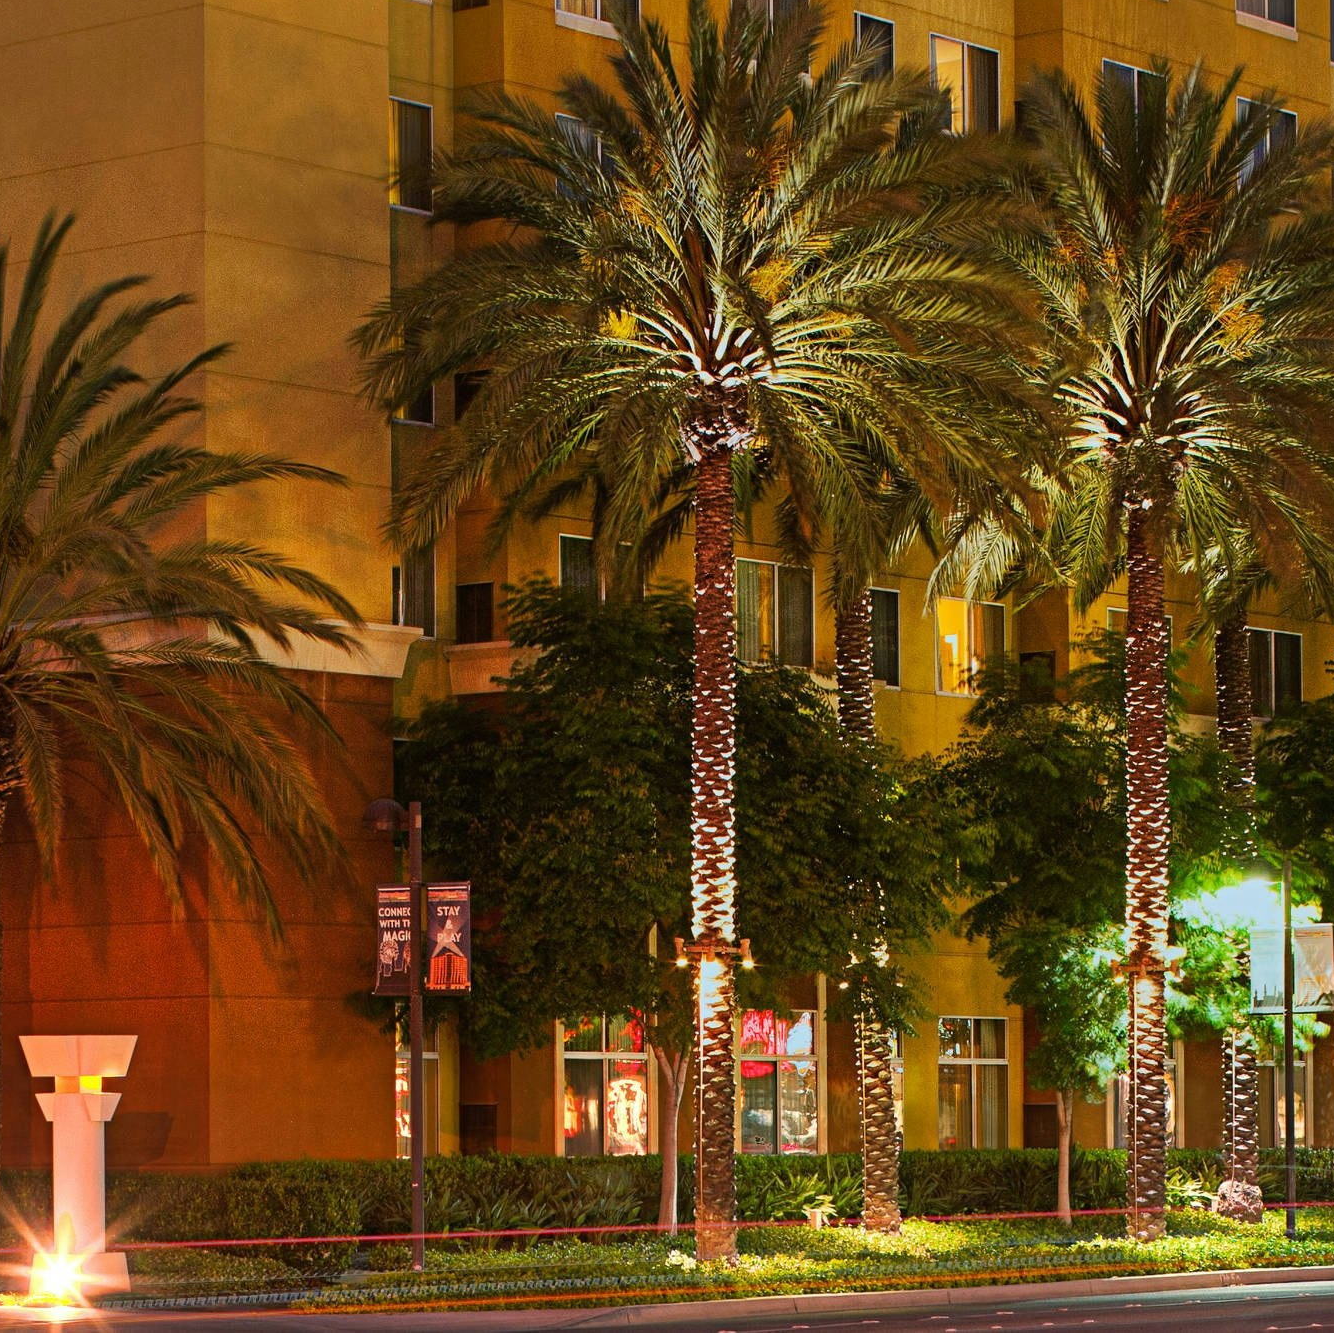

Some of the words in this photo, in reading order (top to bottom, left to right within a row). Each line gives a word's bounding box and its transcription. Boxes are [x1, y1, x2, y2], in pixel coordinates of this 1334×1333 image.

[378, 907, 411, 918] CONNE
[436, 906, 461, 917] STAY
[379, 919, 401, 929] WITH
[446, 919, 454, 930] &
[437, 932, 462, 943] PLAY
